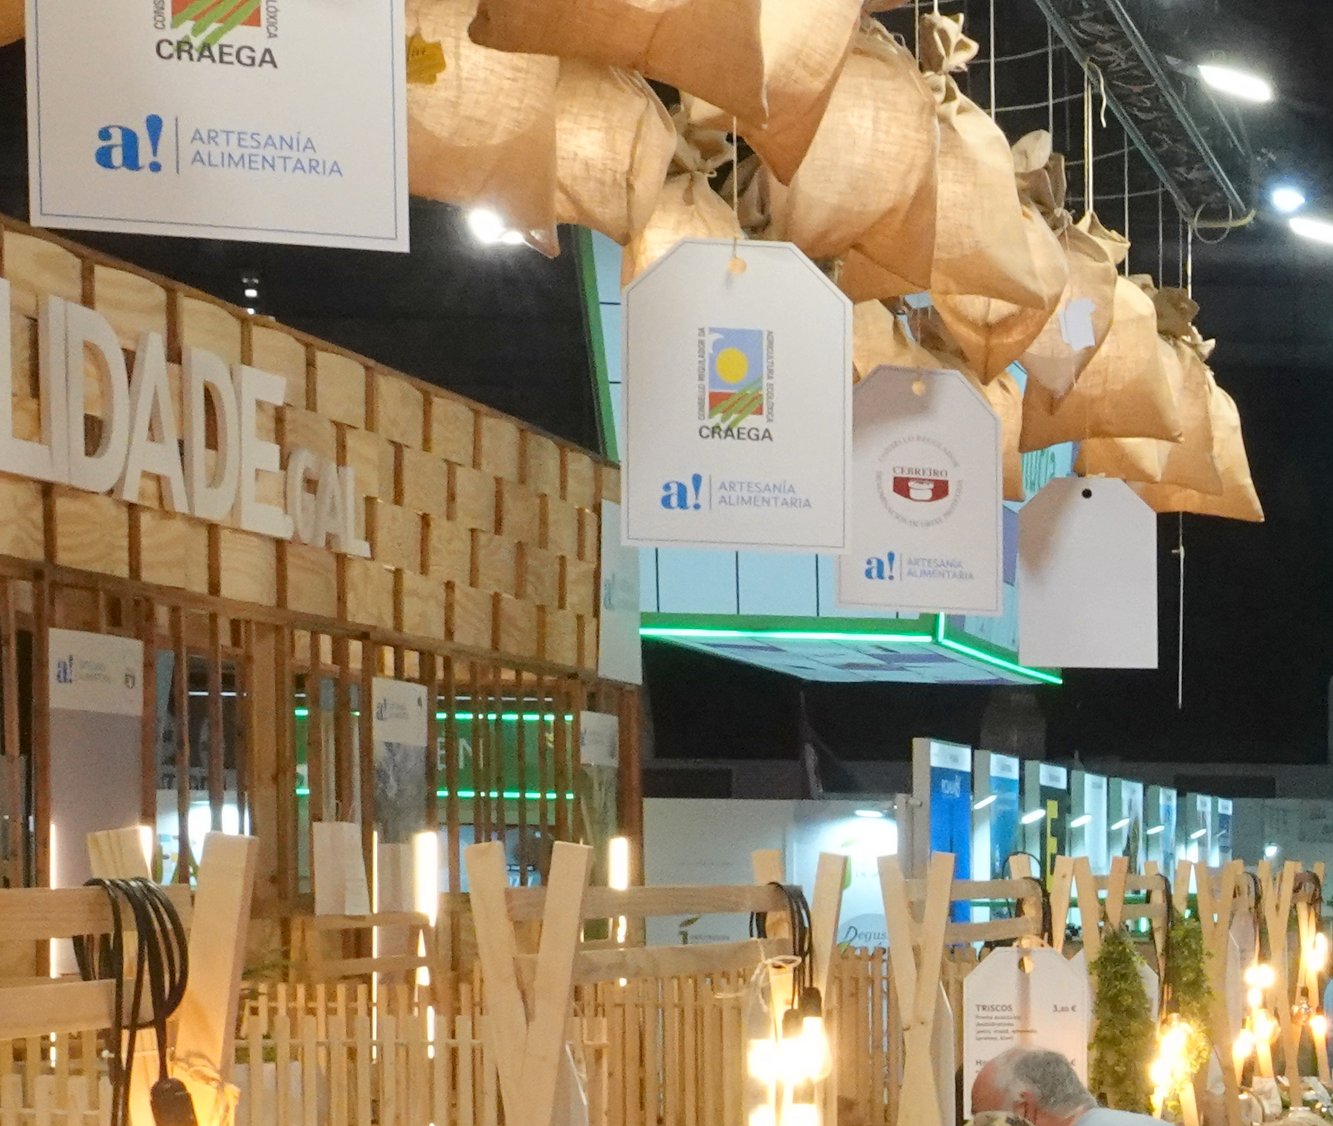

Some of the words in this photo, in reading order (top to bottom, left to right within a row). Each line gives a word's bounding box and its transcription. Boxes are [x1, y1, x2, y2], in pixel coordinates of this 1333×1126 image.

[155, 37, 279, 69] CRAEGA
[190, 127, 318, 154] ARTESANÍA
[190, 149, 345, 177] ALIMENTARIA
[698, 425, 774, 442] CRAEGA
[718, 479, 796, 495] ARTESANÍA
[718, 494, 813, 509] ALIMENTARIA
[975, 1004, 1013, 1012] TRISCOS
